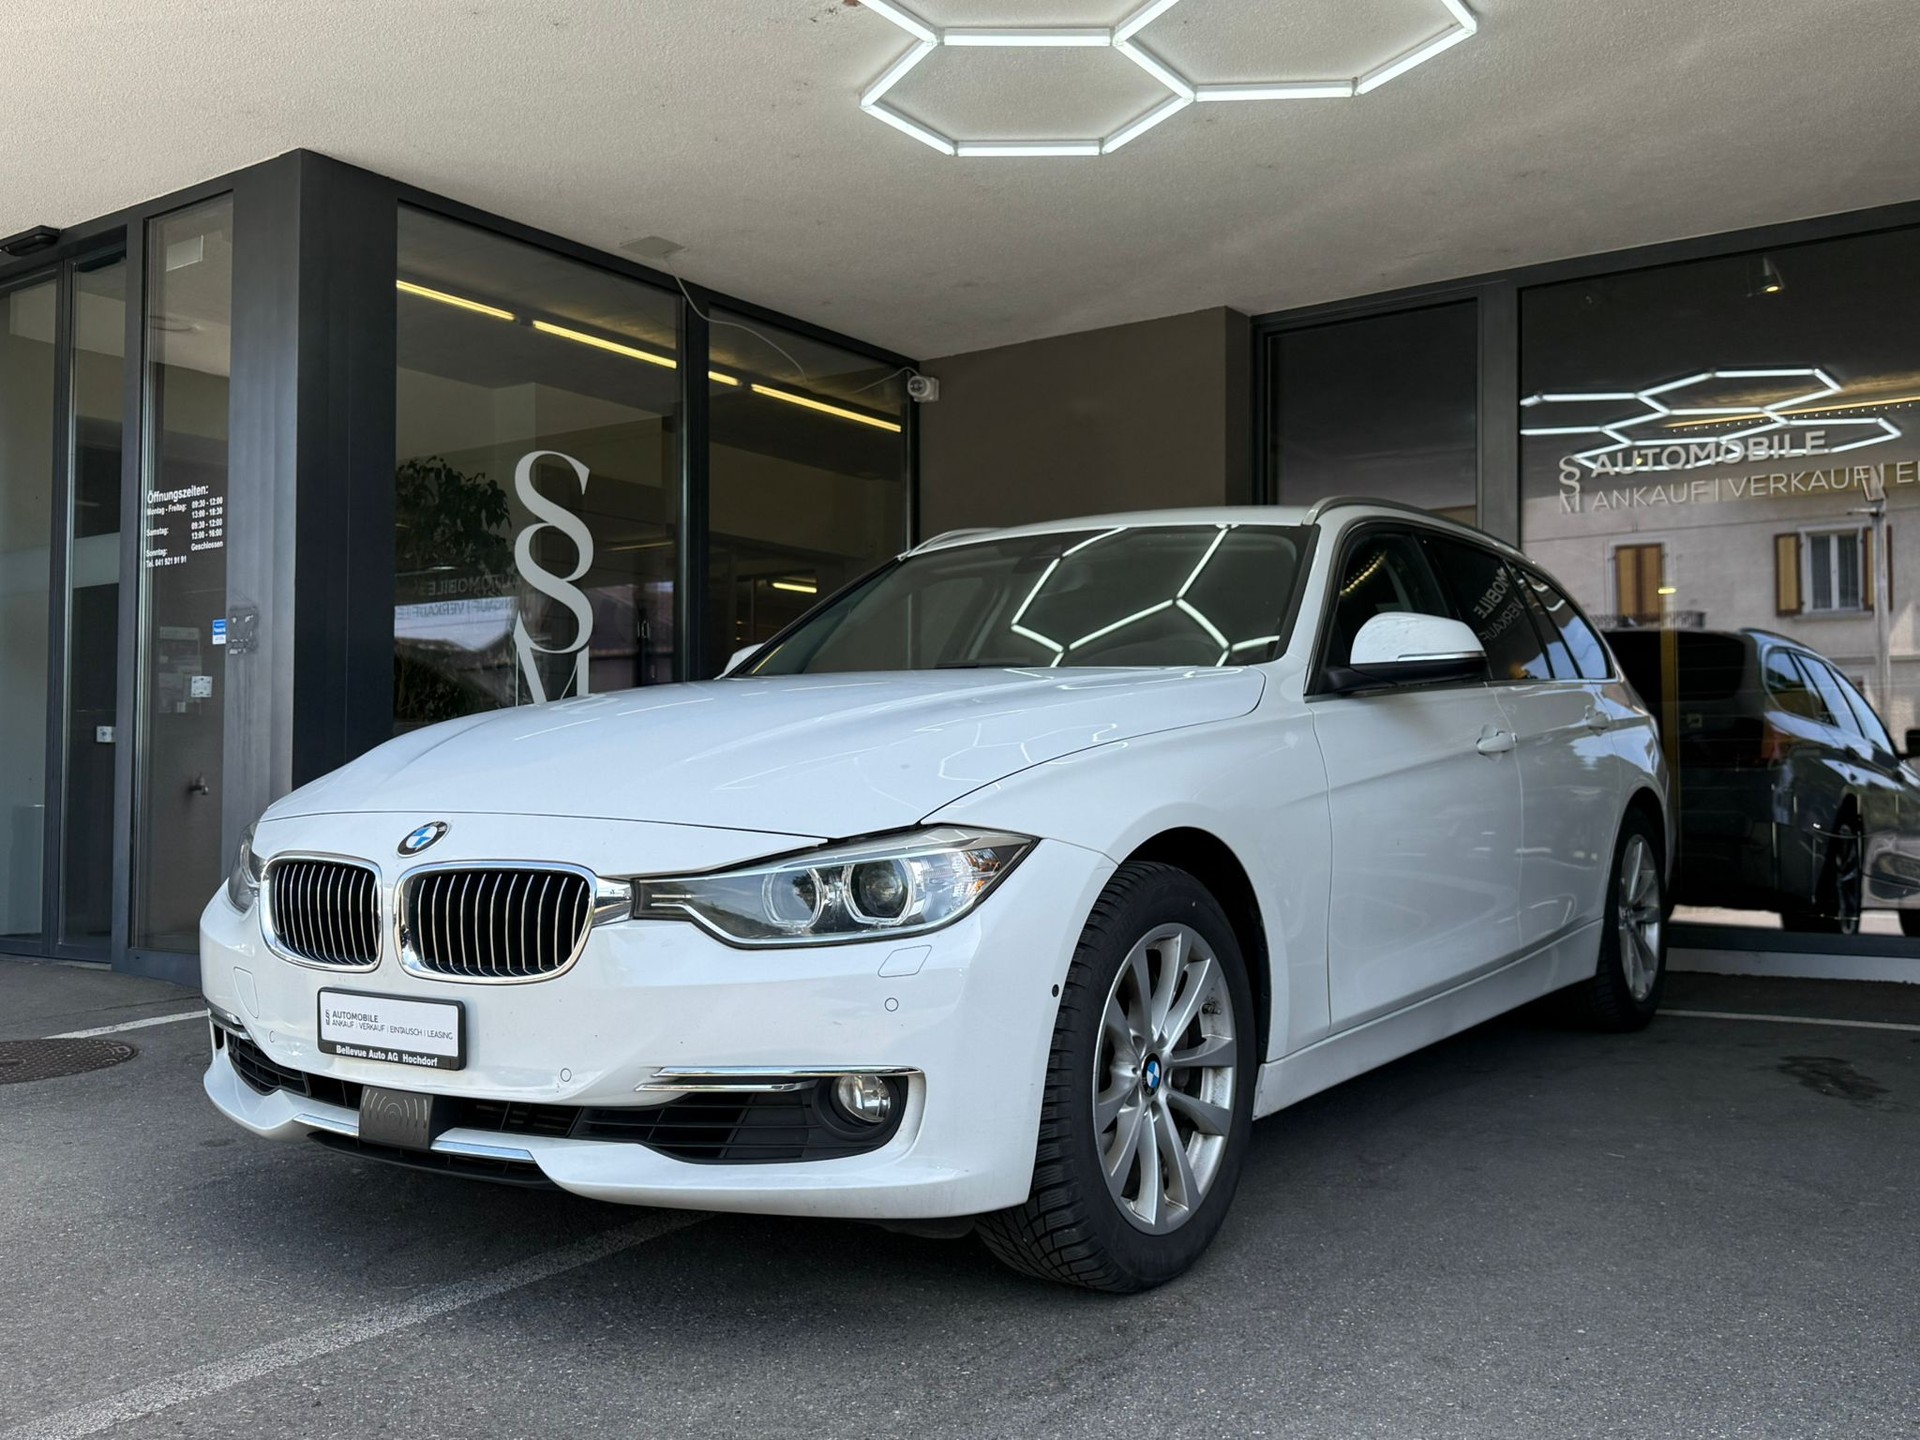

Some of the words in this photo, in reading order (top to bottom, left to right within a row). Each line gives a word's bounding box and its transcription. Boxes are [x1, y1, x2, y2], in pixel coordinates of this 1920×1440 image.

[1591, 430, 1826, 478] AUTOMOBILE
[147, 485, 209, 504] Öffnungszeiten:
[1592, 480, 1706, 510] ANKAUF
[1728, 465, 1870, 498] VERKAUF
[191, 541, 223, 551] Geschlossen
[332, 1010, 379, 1023] AUTOMOBILE
[332, 1020, 355, 1029] ANKAUF
[359, 1023, 386, 1033] VERKAUF
[390, 1025, 422, 1036] EINTAUSCH
[427, 1031, 453, 1040] LEASING
[336, 1045, 367, 1058] Bellevue
[368, 1049, 386, 1060] Auto
[387, 1051, 399, 1062] AG
[402, 1053, 438, 1067] Hochdorf
